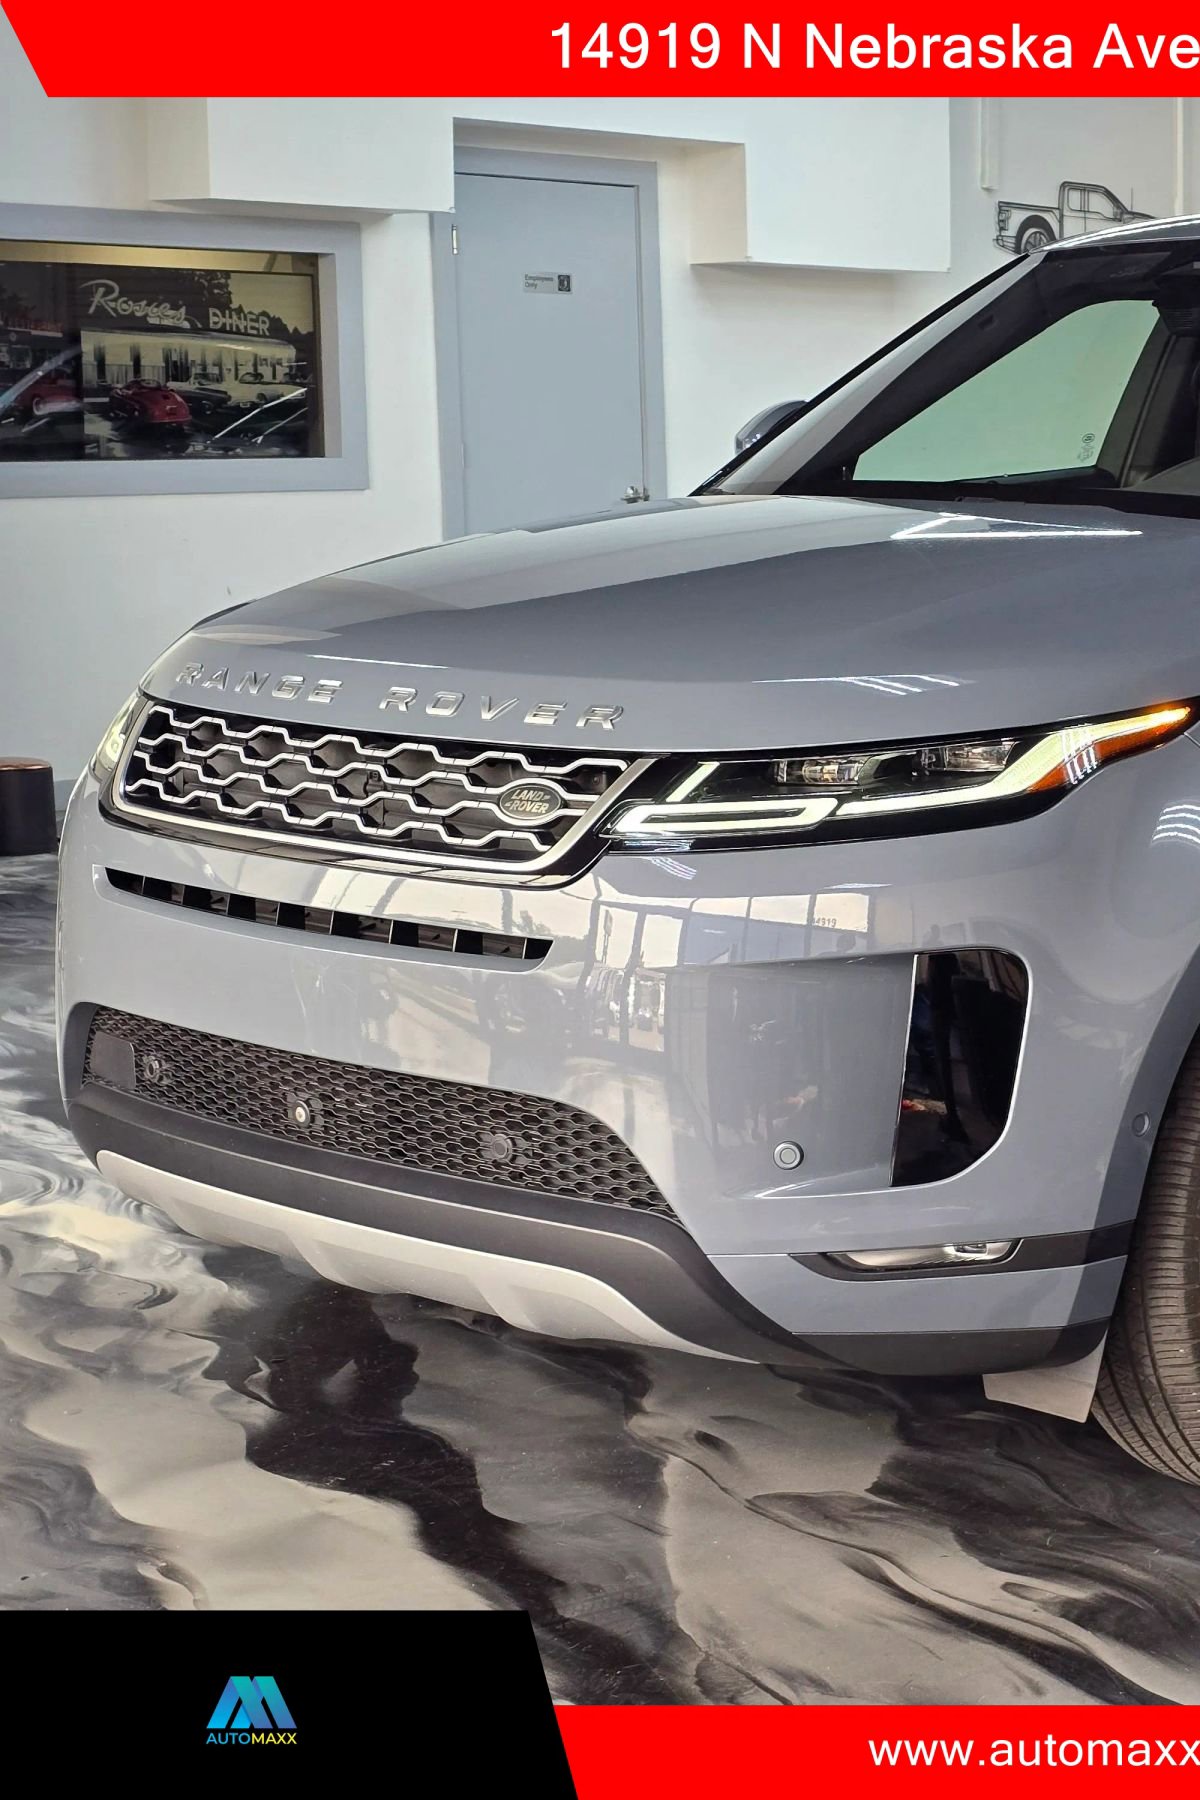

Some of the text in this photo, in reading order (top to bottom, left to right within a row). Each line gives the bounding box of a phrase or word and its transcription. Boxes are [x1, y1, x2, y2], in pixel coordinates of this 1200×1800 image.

[208, 306, 270, 336] DINER
[175, 662, 625, 730] RANGE ROVER
[508, 799, 550, 814] ROVER
